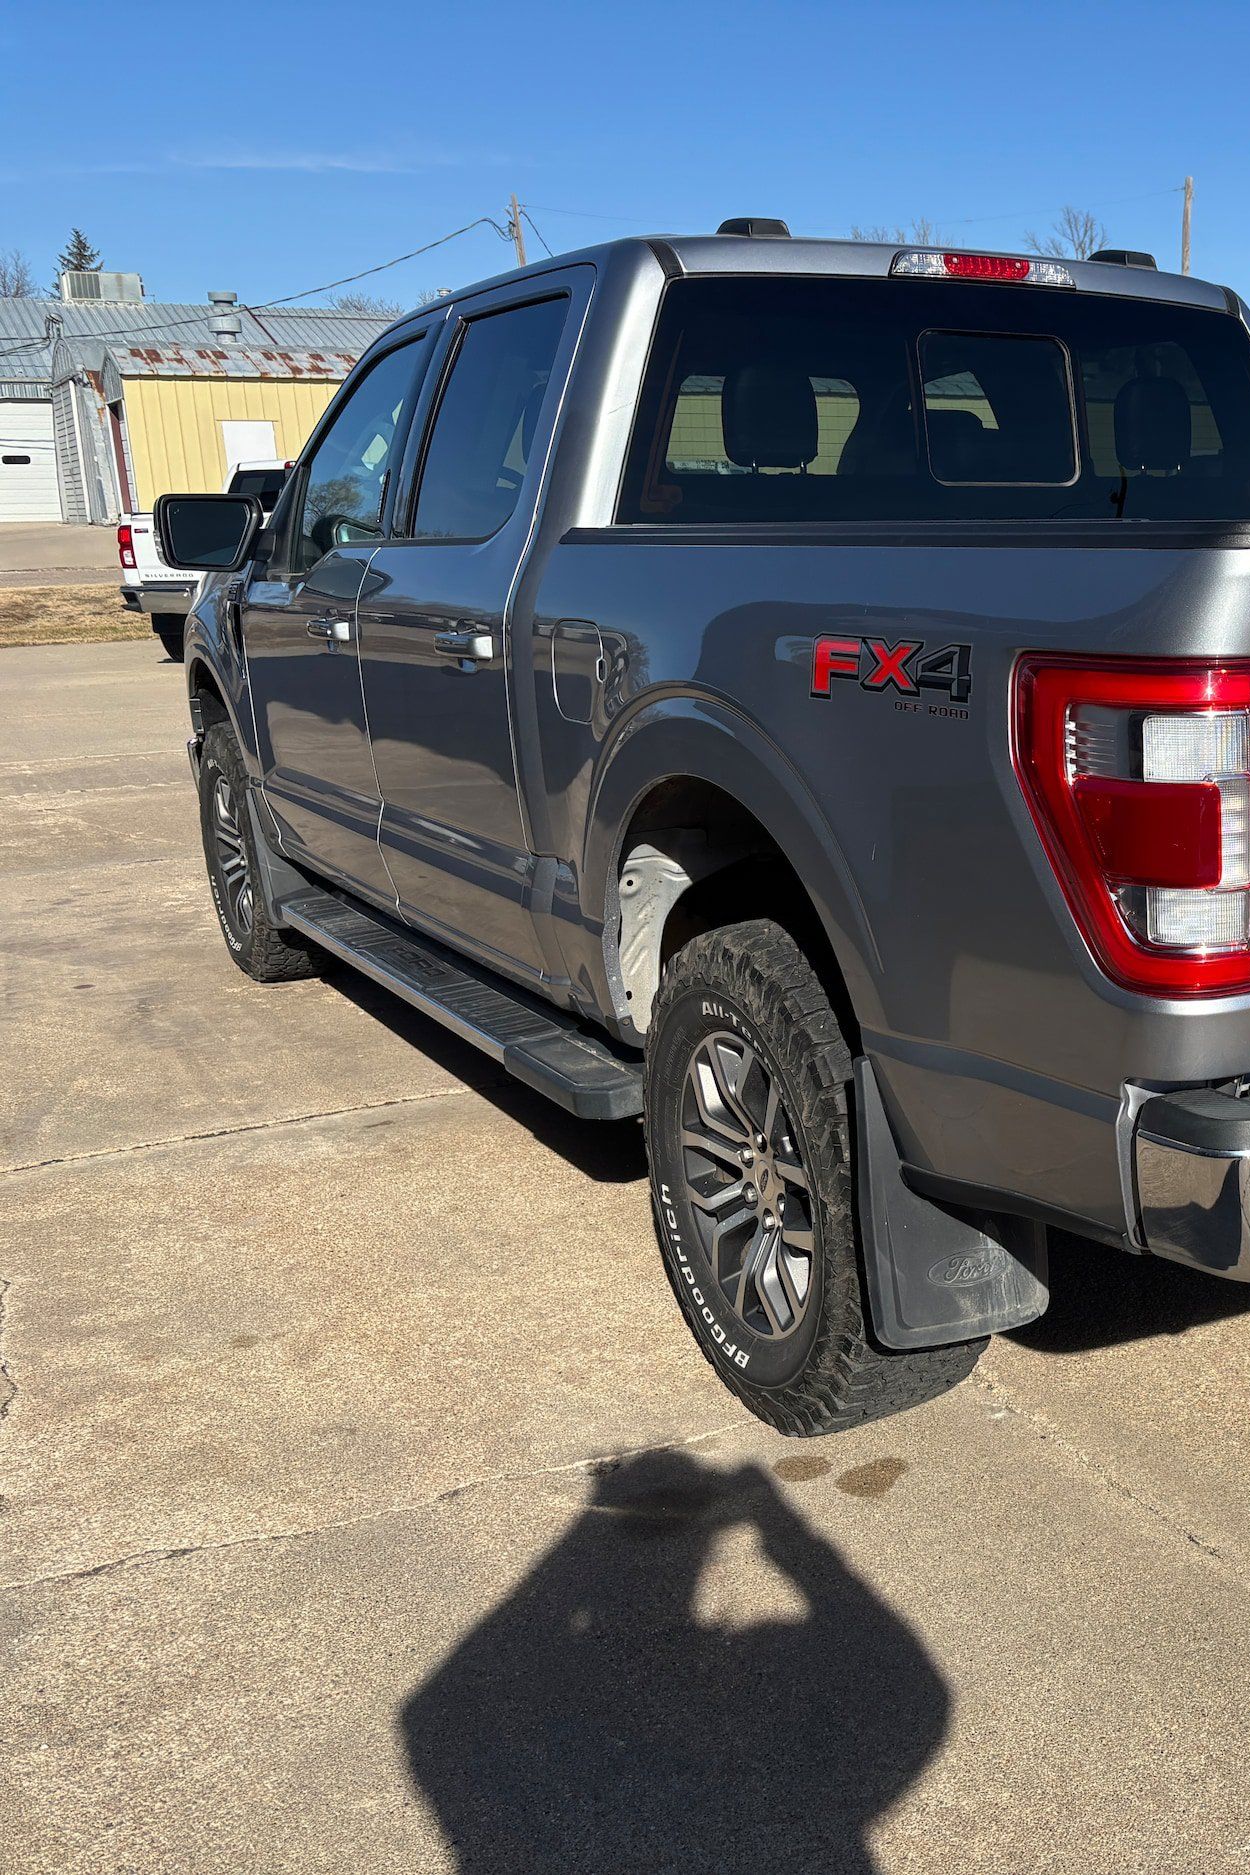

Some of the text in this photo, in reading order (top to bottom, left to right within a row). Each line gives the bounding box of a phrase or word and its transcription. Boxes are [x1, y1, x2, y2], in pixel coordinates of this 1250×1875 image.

[809, 632, 972, 704] FX4
[894, 701, 969, 720] OFF ROAD
[660, 1183, 751, 1370] BFGoodrich
